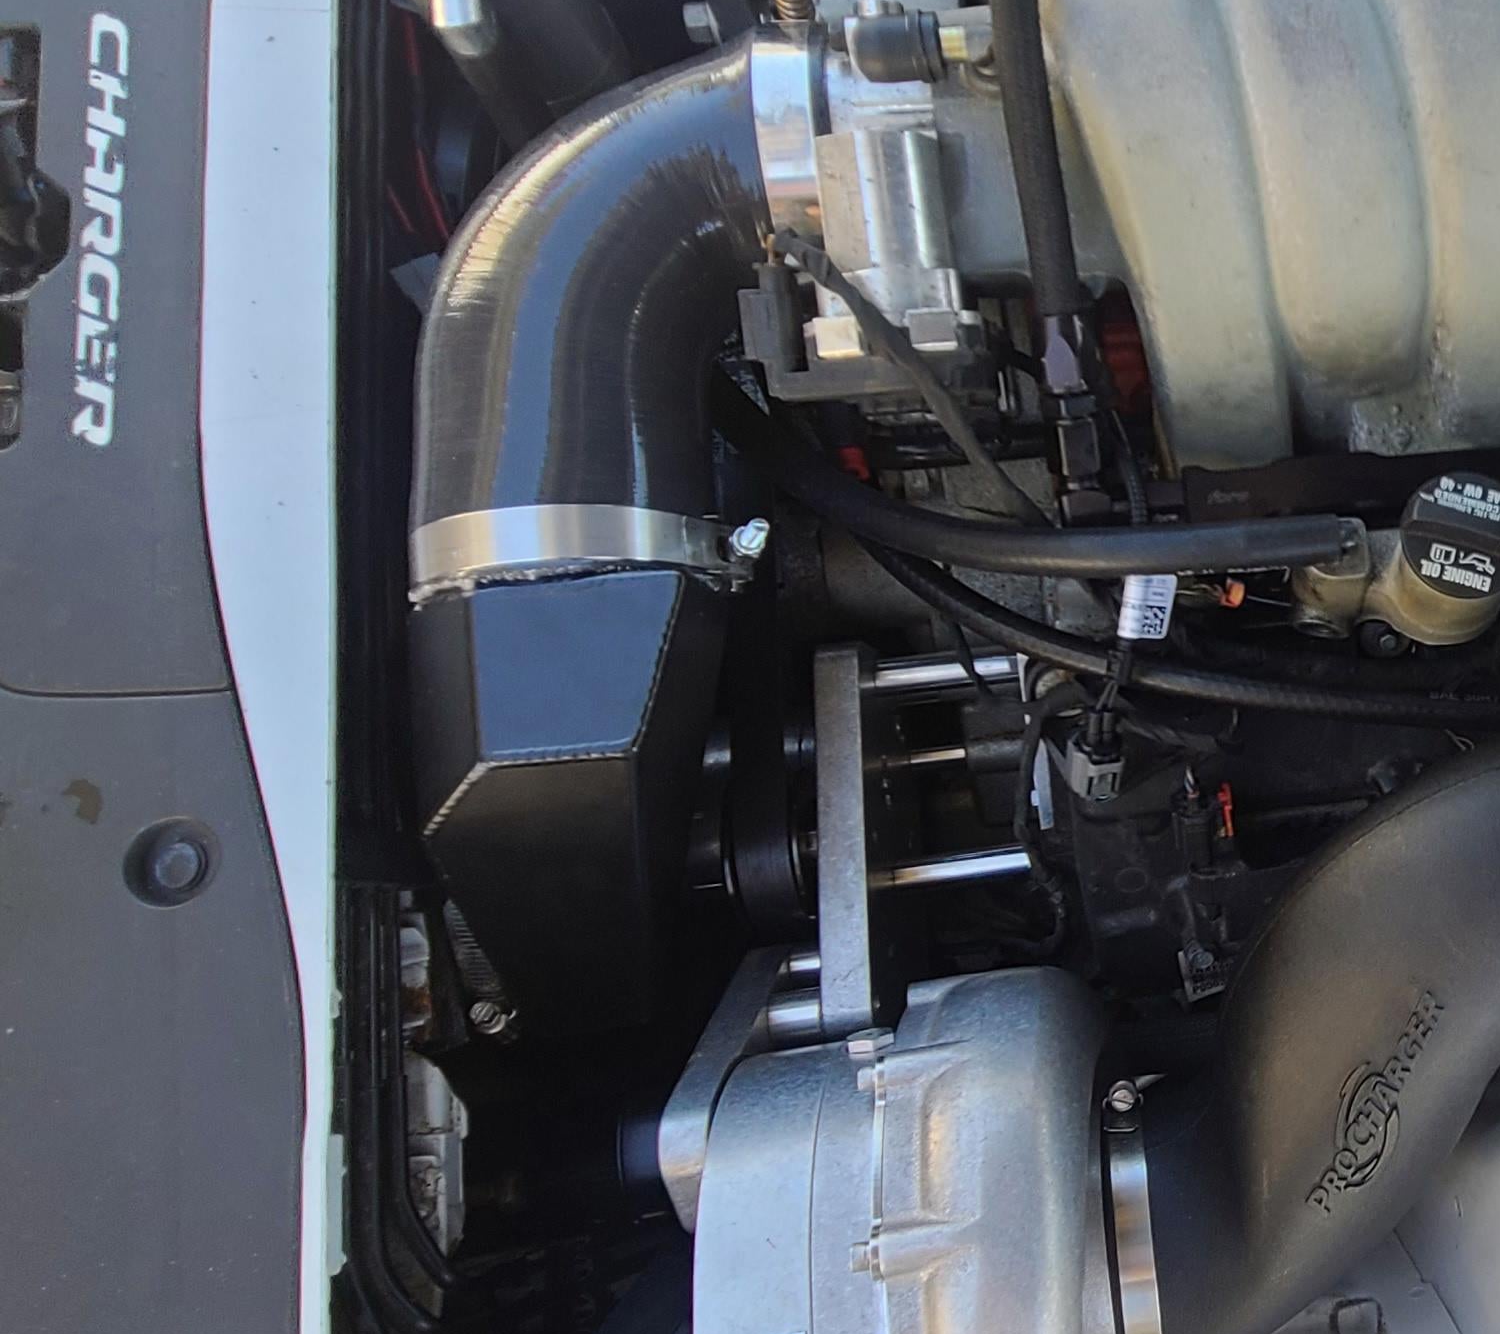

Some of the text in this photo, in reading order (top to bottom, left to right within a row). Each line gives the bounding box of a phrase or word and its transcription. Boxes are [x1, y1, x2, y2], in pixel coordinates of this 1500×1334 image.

[71, 11, 130, 447] CHARGER
[1420, 559, 1492, 593] ENGINE OIL
[1305, 989, 1445, 1214] PROCHARGER
